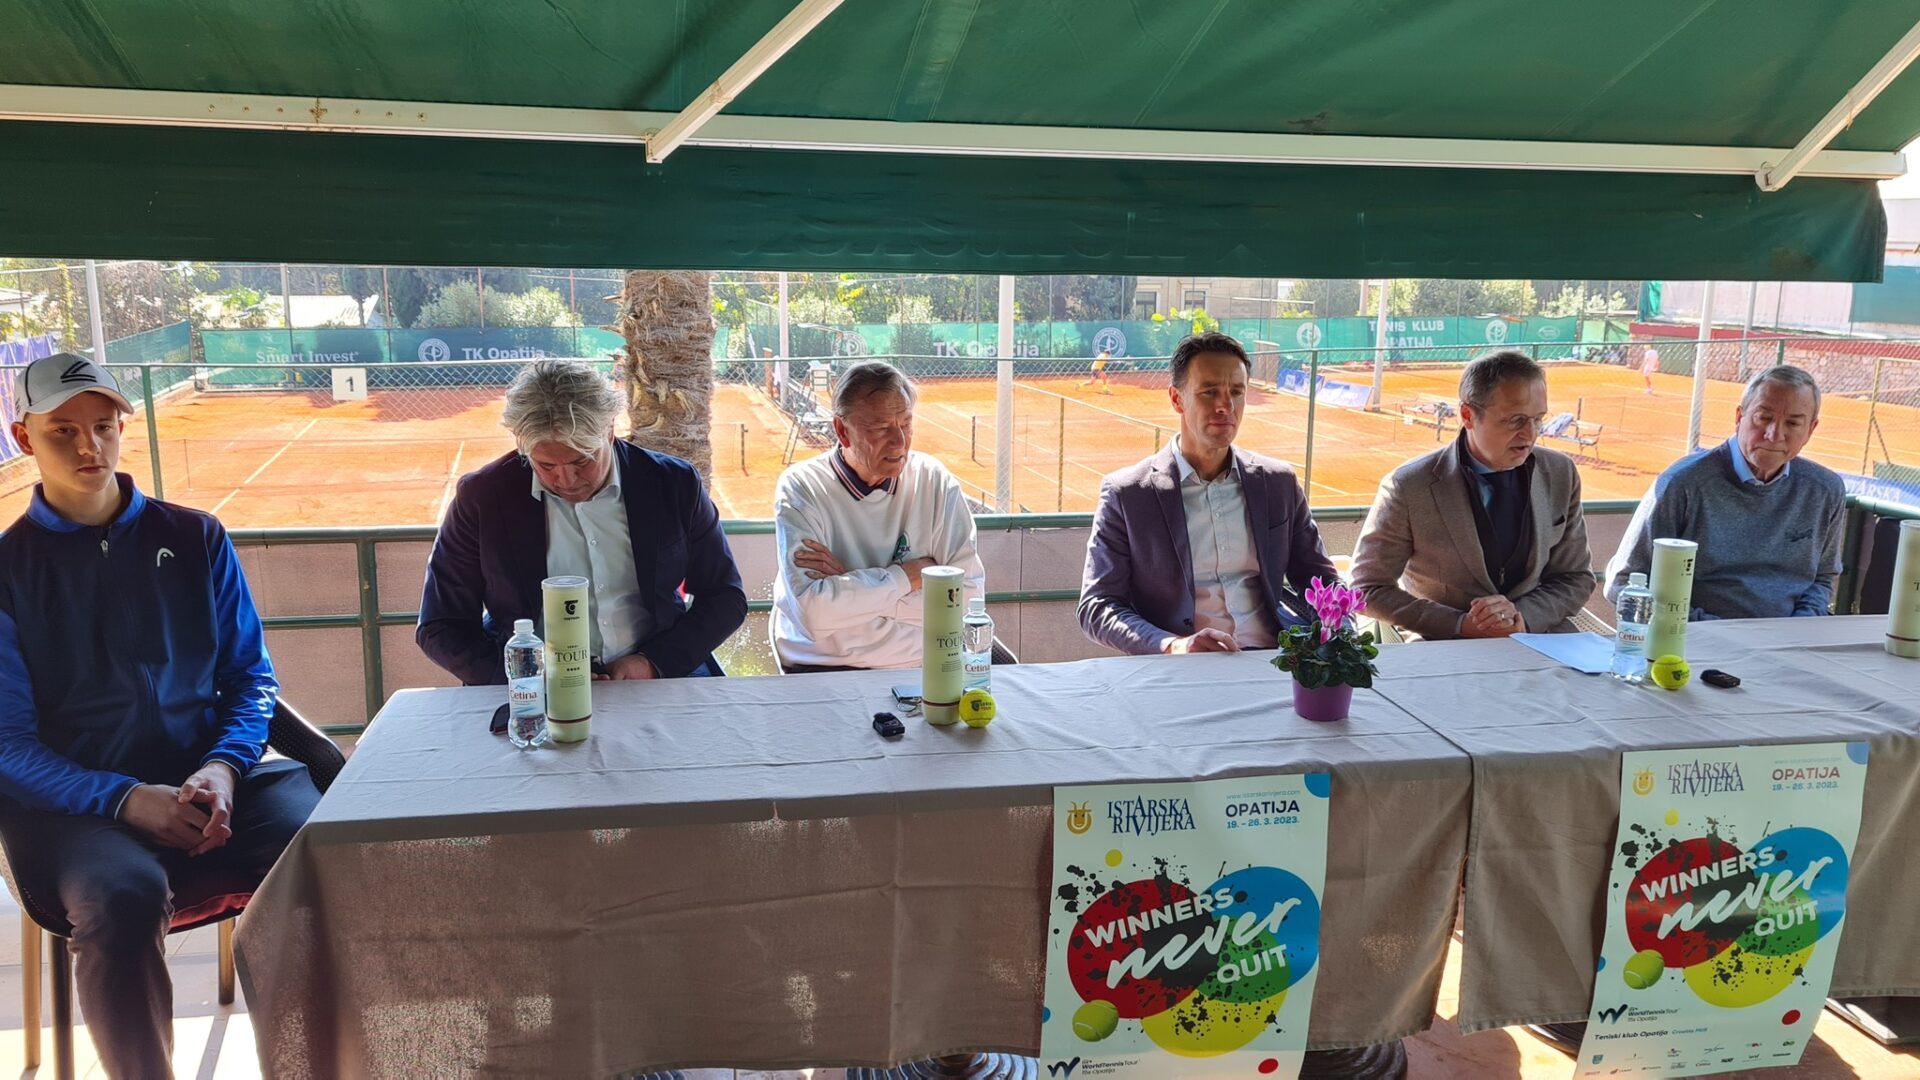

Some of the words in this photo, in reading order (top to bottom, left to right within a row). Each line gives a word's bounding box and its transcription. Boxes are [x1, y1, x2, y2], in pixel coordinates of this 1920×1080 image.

[1368, 320, 1406, 332] TNIS
[1412, 320, 1444, 332] KLUB
[256, 351, 303, 363] Smart
[461, 347, 483, 360] TK
[932, 341, 960, 358] TK
[966, 339, 1040, 358] Opija
[345, 376, 354, 392] 1
[555, 649, 588, 663] TOUR
[1667, 759, 1741, 781] ISTARSKA
[1772, 766, 1841, 781] OPATIJA
[1671, 775, 1745, 797] RIVIJERA
[1107, 795, 1191, 818] ISTARSKA
[1225, 800, 1300, 817] OPATIJA
[1112, 813, 1196, 837] RIVIJERA
[1640, 846, 1776, 902] WINNERS
[1657, 856, 1834, 940] never
[1084, 887, 1234, 948] WINNERS
[1753, 900, 1819, 937] QUIT
[1106, 897, 1302, 990] never
[1216, 944, 1288, 984] QUIT
